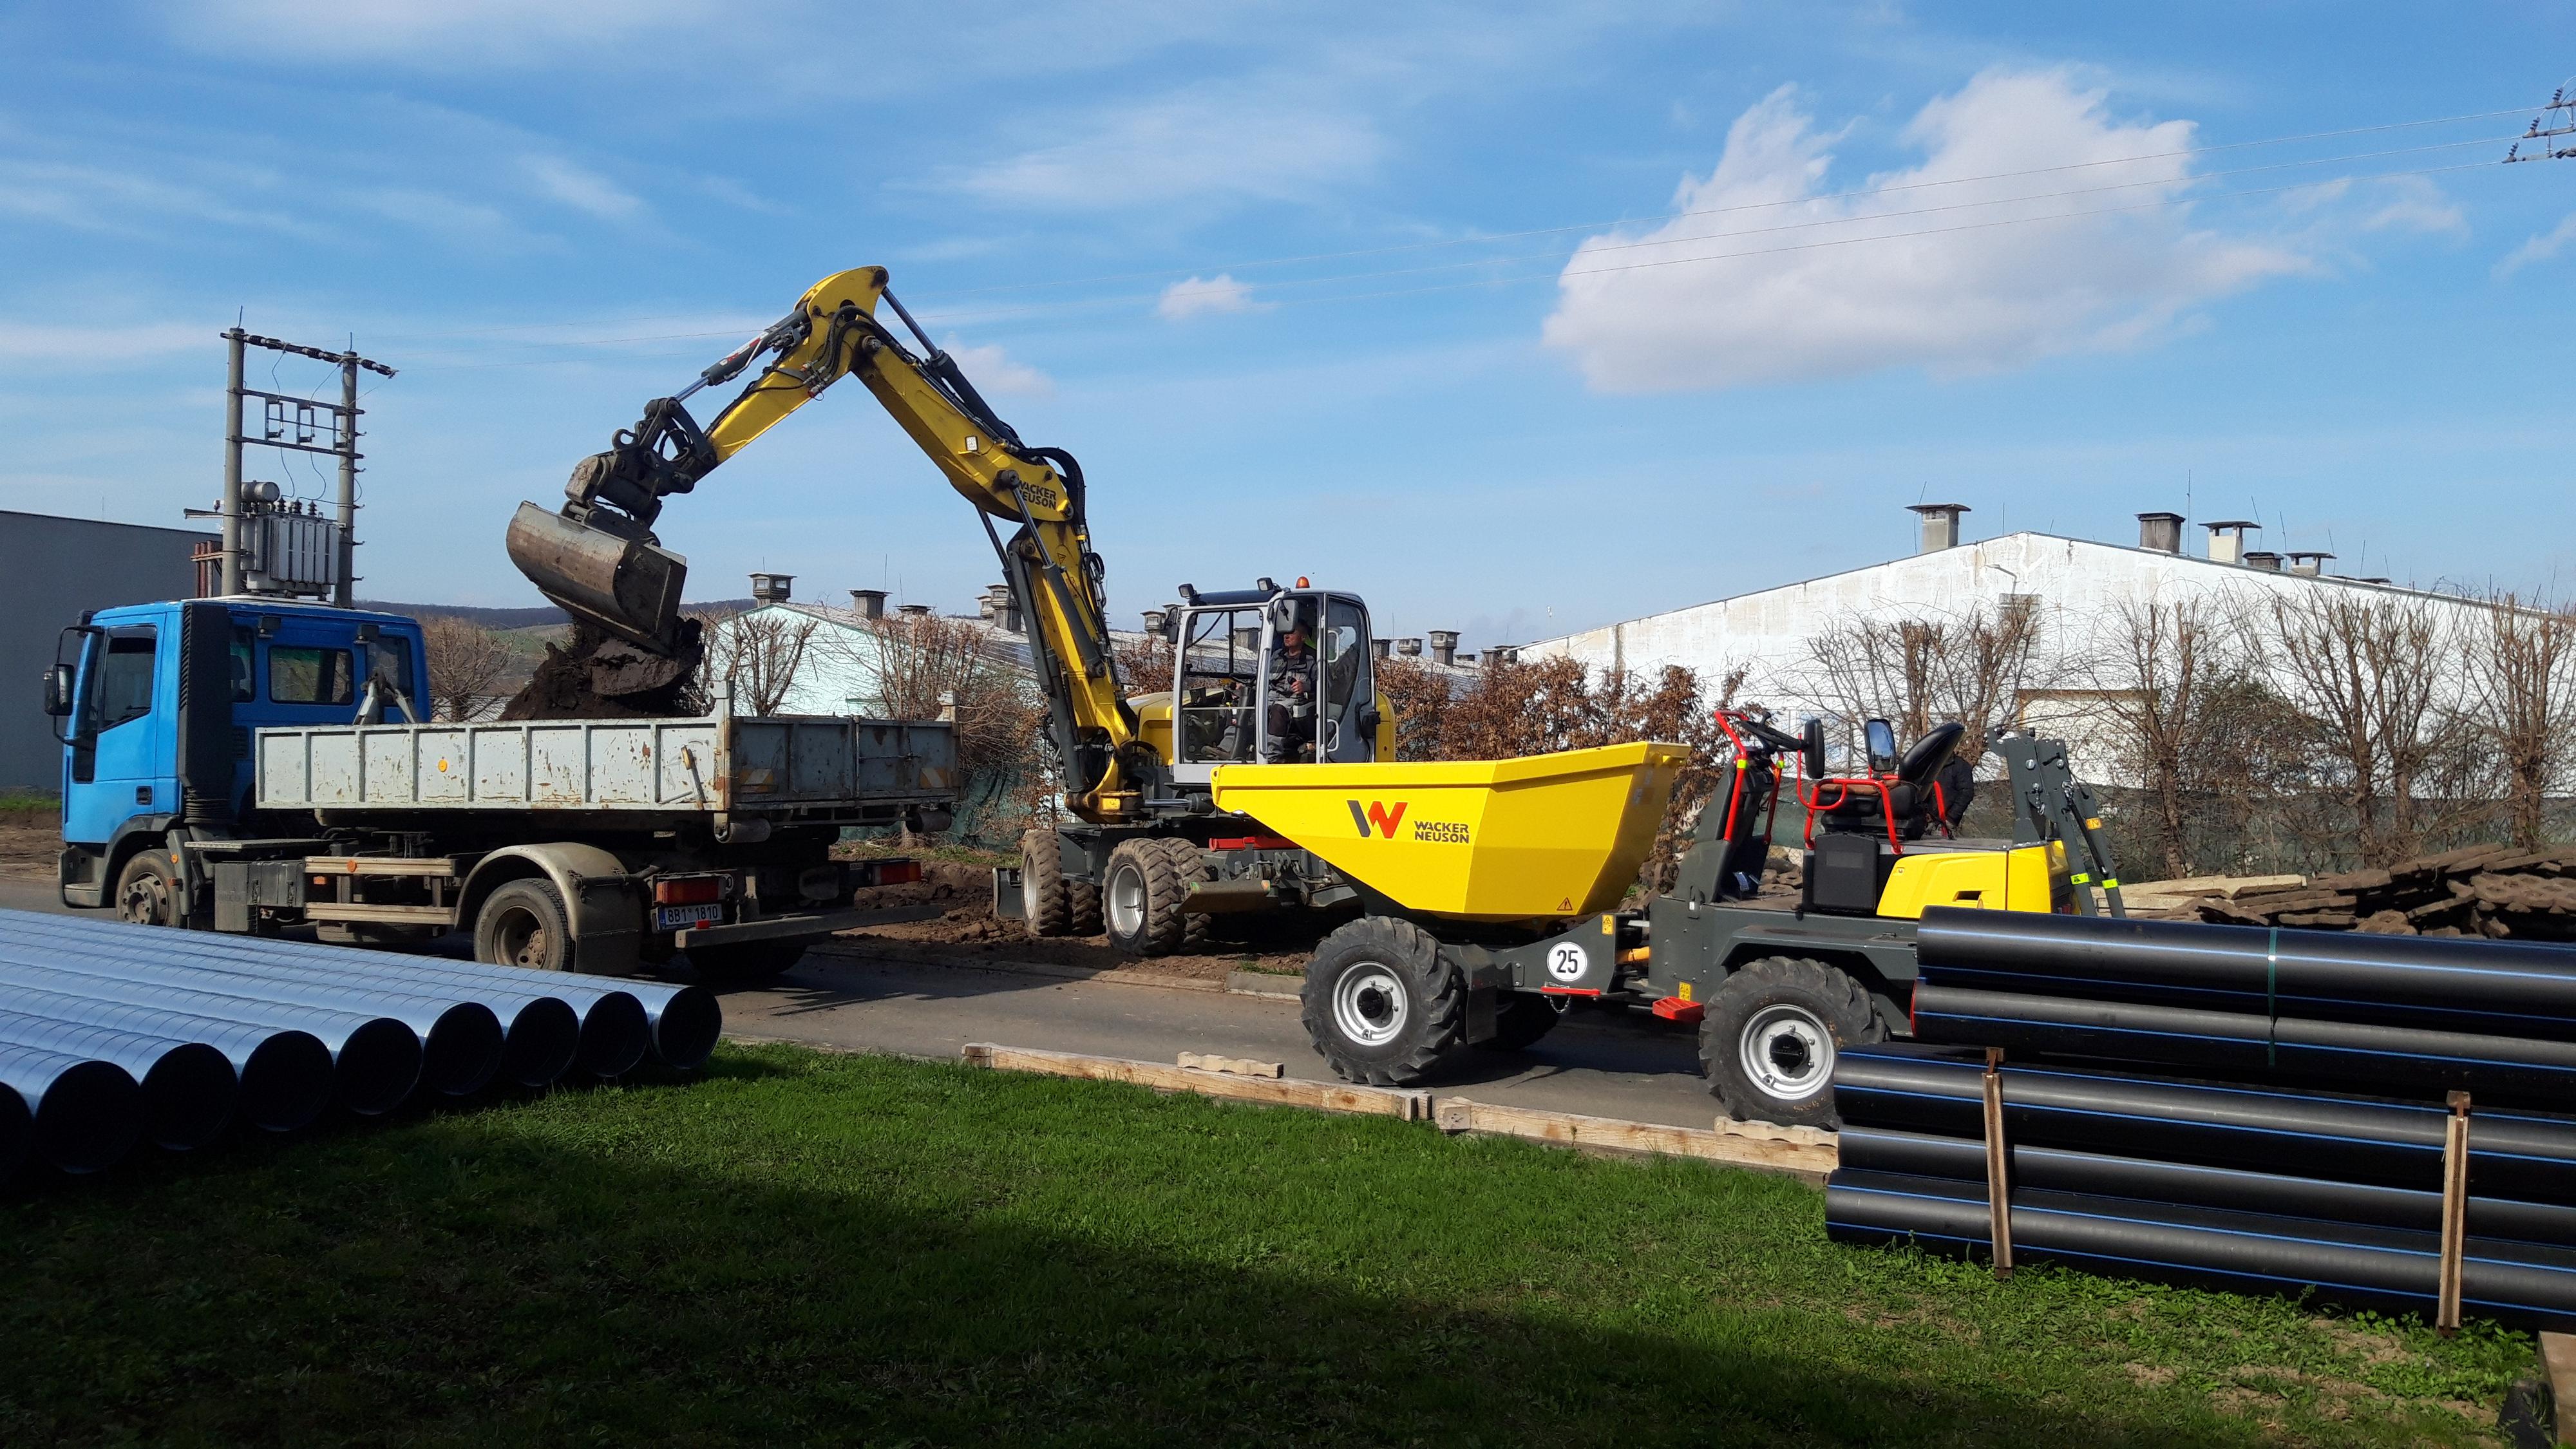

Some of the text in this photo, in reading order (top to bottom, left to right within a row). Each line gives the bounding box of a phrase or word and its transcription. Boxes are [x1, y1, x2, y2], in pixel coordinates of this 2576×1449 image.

[1019, 490, 1057, 510] EUSON
[1414, 820, 1469, 833] WACKER
[1414, 831, 1470, 844] NEUSON
[668, 906, 718, 922] 8B1 1810
[1556, 949, 1578, 974] 25
